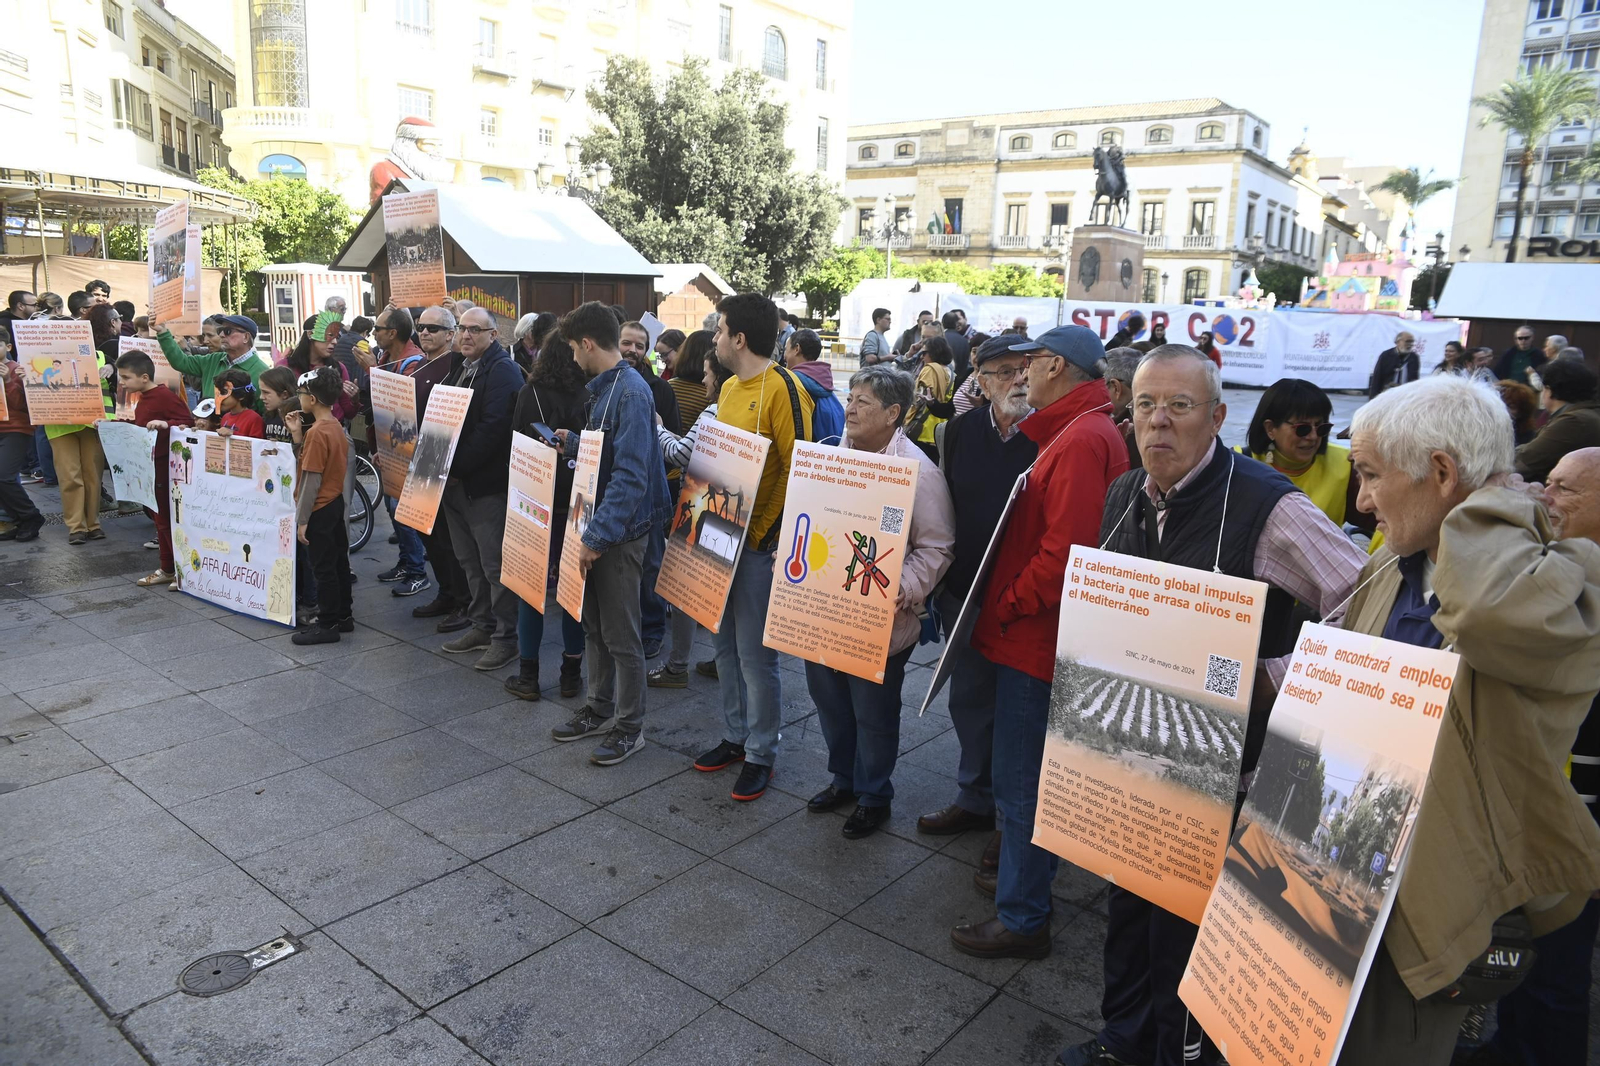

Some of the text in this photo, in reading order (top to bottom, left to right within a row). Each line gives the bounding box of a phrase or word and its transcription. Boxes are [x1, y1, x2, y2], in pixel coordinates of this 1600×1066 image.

[472, 286, 516, 320] Climática
[1187, 312, 1256, 347] CO2
[697, 433, 761, 464] JUSTICIA SOCIAL deben ir
[705, 425, 725, 438] JUSTICIA
[725, 433, 752, 449] AMBIENTAL
[705, 449, 717, 458] mano
[795, 460, 812, 468] poda
[825, 466, 845, 475] verde
[860, 472, 876, 480] está
[878, 475, 910, 486] pensada
[797, 448, 826, 460] Replican
[835, 455, 886, 471] Ayuntamiento
[888, 466, 903, 474] que
[904, 467, 912, 476] la
[810, 472, 836, 484] árboles
[837, 478, 867, 490] urbanos
[202, 557, 220, 574] AFA
[1073, 557, 1254, 606] El calentamiento global impulsa
[185, 571, 196, 590] Con
[198, 573, 205, 592] la
[235, 591, 243, 604] de
[1069, 588, 1150, 617] el Mediterráneo
[1071, 572, 1251, 624] la bacteria que arrasa olivos en
[1125, 650, 1140, 660] SINC,
[1157, 660, 1172, 669] mayo
[1181, 666, 1195, 675] 2024
[1300, 638, 1452, 691] ¿Quién encontrará empleo
[1284, 681, 1323, 706] desierto?
[1292, 662, 1443, 719] en Córdoba cuando sea un
[1046, 770, 1064, 782] centra
[1084, 785, 1108, 801] impacto
[1110, 796, 1119, 806] de
[1121, 800, 1127, 809] la
[1129, 806, 1159, 822] infección
[1160, 817, 1180, 831] junto
[1191, 832, 1218, 848] cambio
[1048, 758, 1061, 770] Esta
[1064, 766, 1081, 779] nueva
[1085, 776, 1125, 798] investigación,
[1129, 792, 1155, 810] liderada
[1159, 807, 1171, 816] por
[1186, 816, 1205, 832] CSIC,
[1210, 828, 1220, 837] se
[1044, 788, 1214, 870] denominación de origen. Para ello, han evaluado los
[1045, 779, 1070, 795] climático
[1081, 795, 1104, 810] viñedos
[1111, 808, 1130, 821] zonas
[1131, 818, 1162, 835] europeas
[1164, 831, 1200, 853] protegidas
[1202, 848, 1216, 859] con
[1041, 818, 1164, 882] unos insectos conocidos como chicharras.
[1042, 808, 1067, 824] epidemia
[1069, 821, 1087, 834] global
[1088, 830, 1097, 838] de
[1158, 863, 1171, 874] que
[1173, 869, 1212, 892] transmiten
[1043, 798, 1213, 881] diferentes escenarios en los que se desarrolla la
[1218, 885, 1253, 925] creación de empleo.
[1223, 871, 1343, 988] Que no nos sigan engañando con la excusa de la
